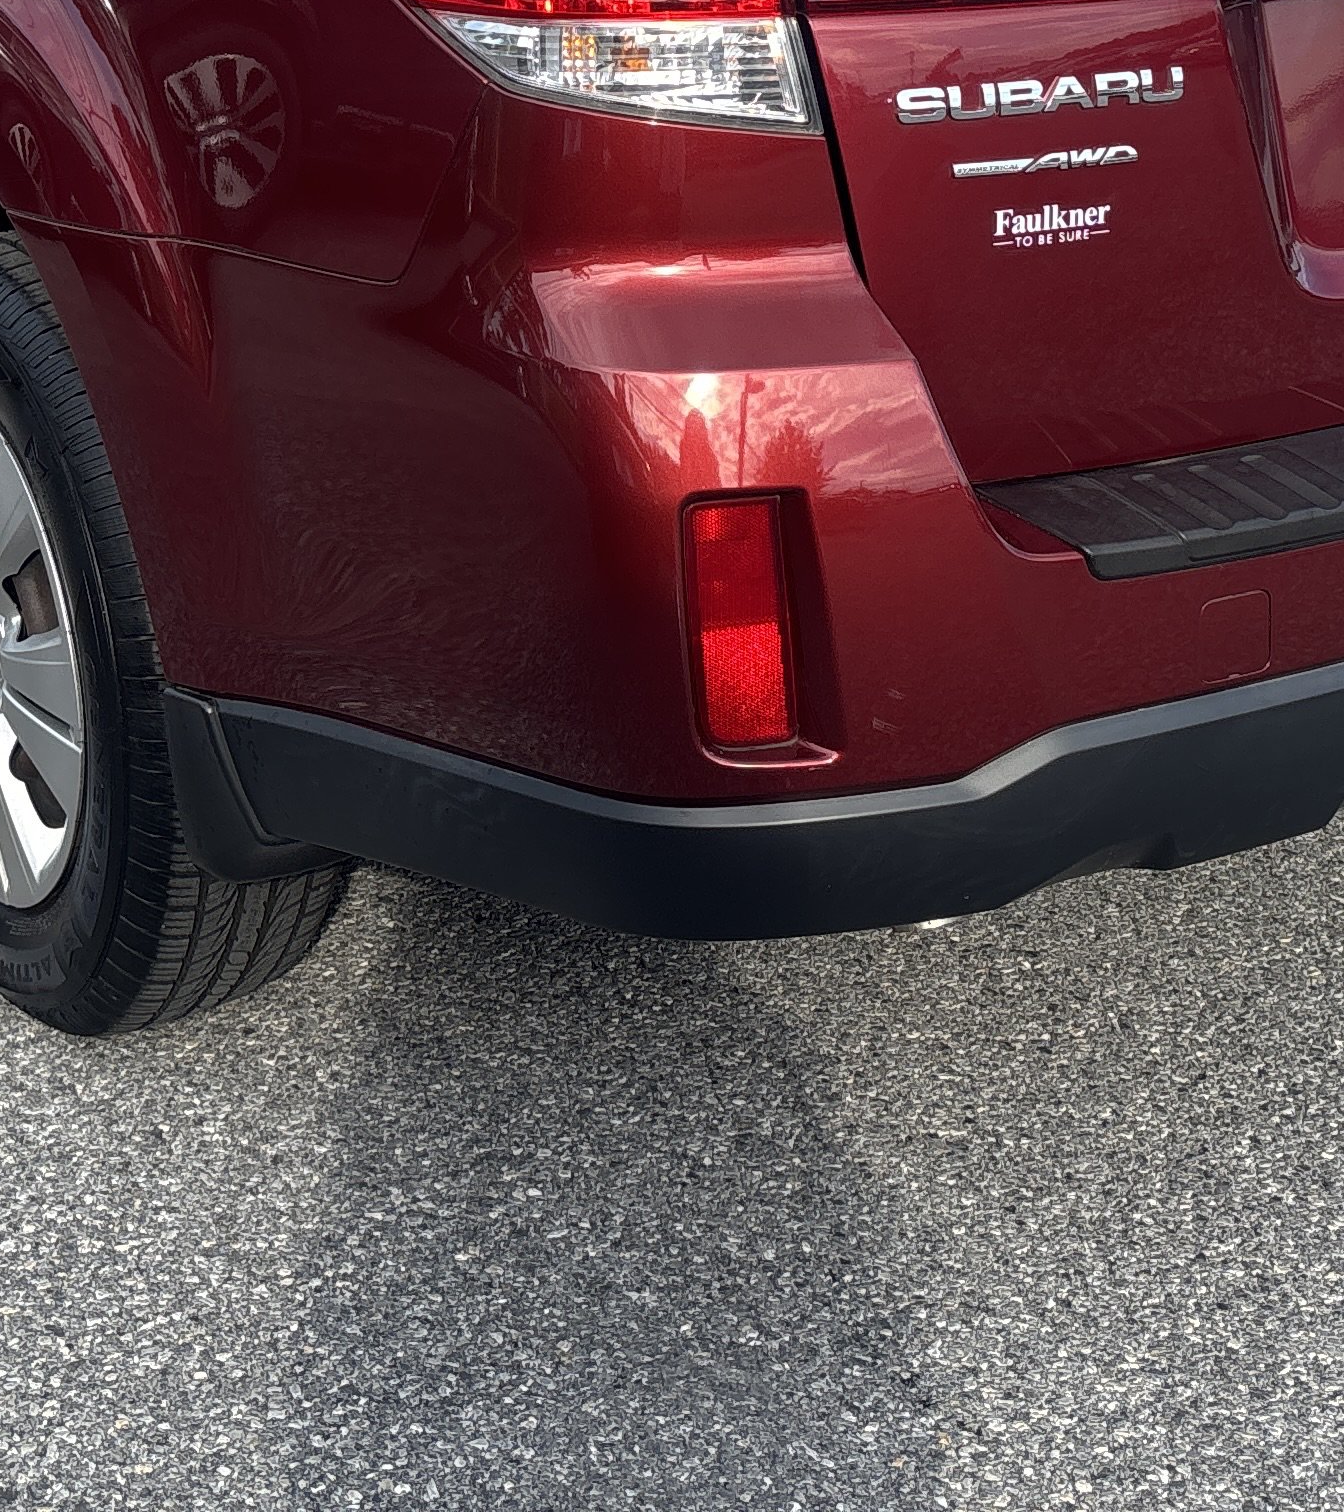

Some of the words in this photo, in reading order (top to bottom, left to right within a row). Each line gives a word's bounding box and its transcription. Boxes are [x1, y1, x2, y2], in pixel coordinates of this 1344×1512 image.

[895, 66, 1185, 125] SUBARU
[956, 163, 1020, 175] SYMMETRICAL
[1024, 144, 1139, 174] AWD
[993, 204, 1111, 237] Faulkner
[1014, 235, 1033, 248] TO
[1037, 233, 1053, 245] BE
[1058, 228, 1090, 243] SURE
